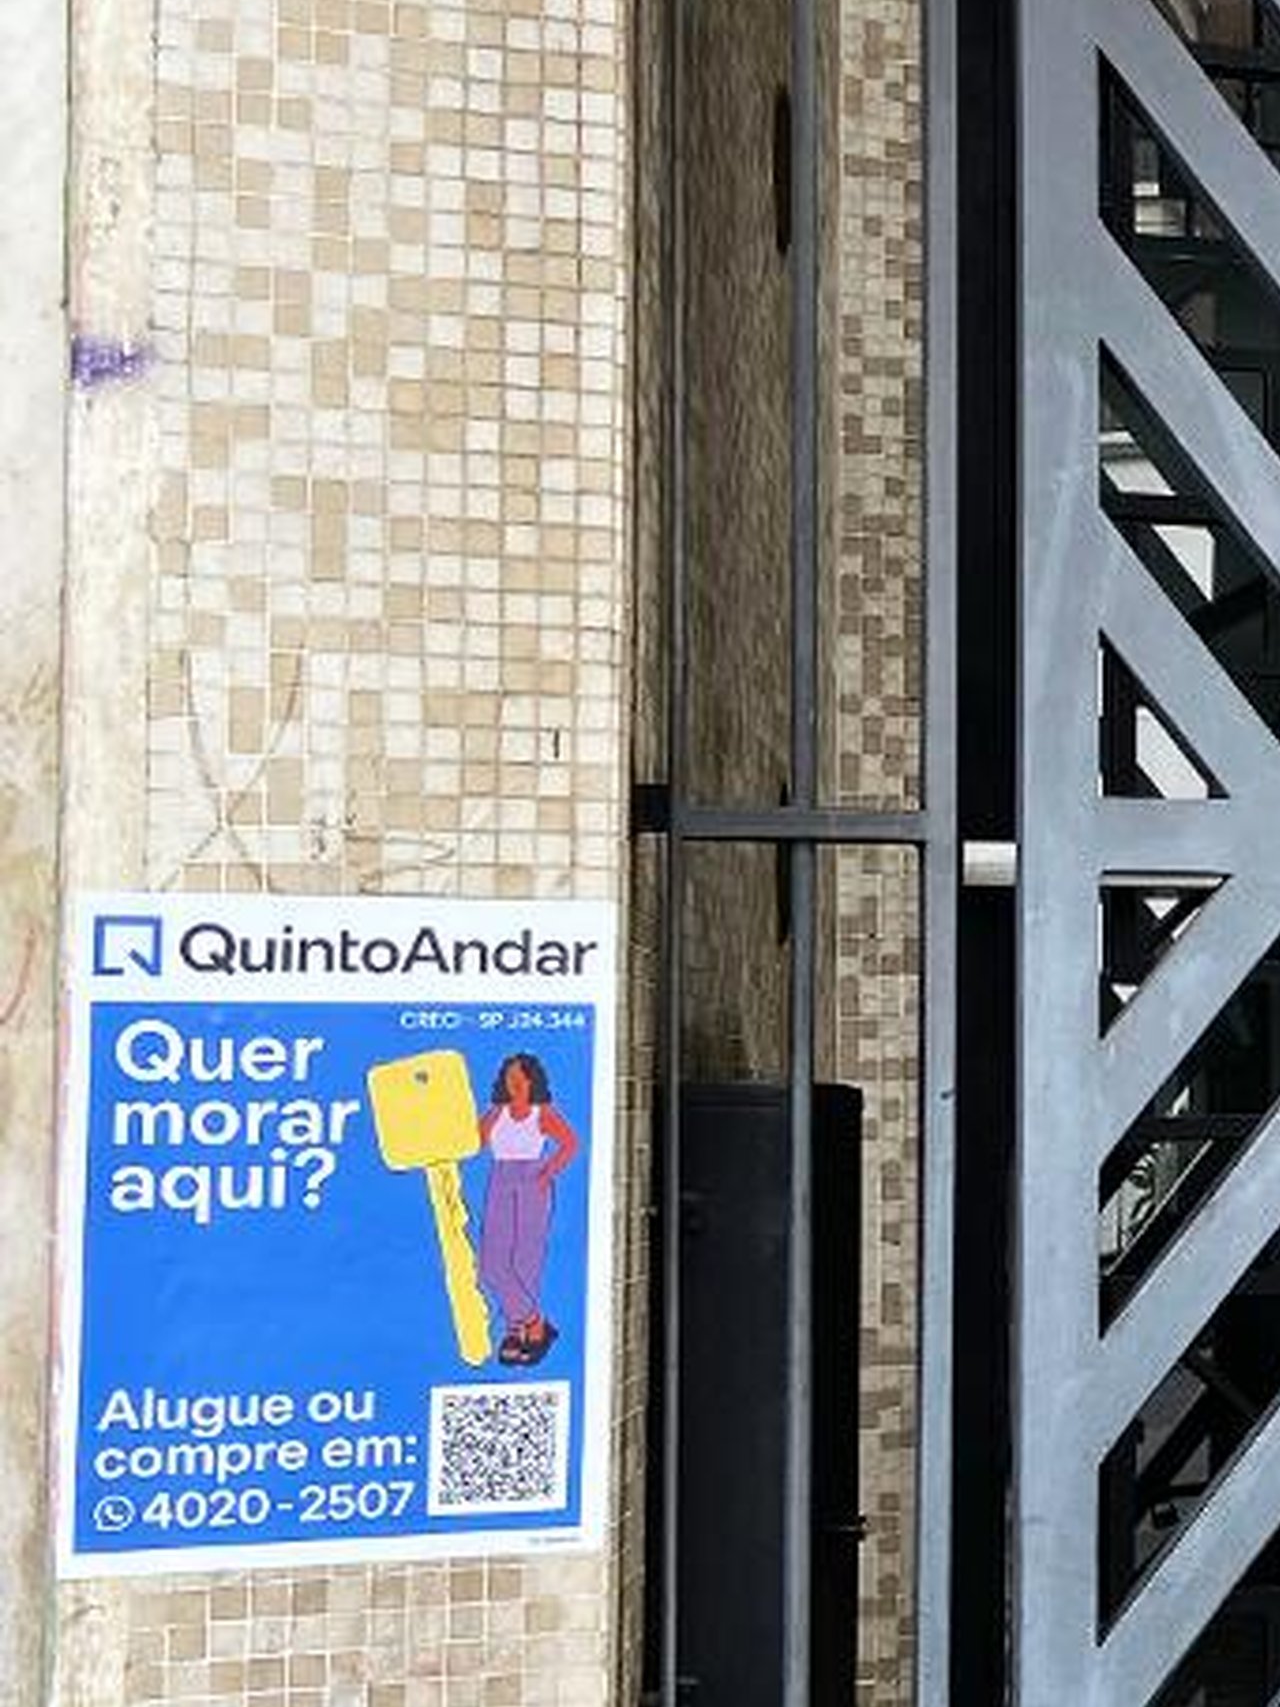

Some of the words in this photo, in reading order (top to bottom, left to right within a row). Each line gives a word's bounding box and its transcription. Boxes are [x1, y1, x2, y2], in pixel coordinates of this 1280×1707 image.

[178, 922, 598, 977] QuintoAndar
[114, 1018, 324, 1083] Quer
[112, 1098, 361, 1146] morar
[110, 1147, 337, 1224] aqui?
[98, 1388, 294, 1437] Alugue
[307, 1391, 375, 1423] ou
[95, 1439, 309, 1483] compre
[322, 1435, 418, 1469] em:
